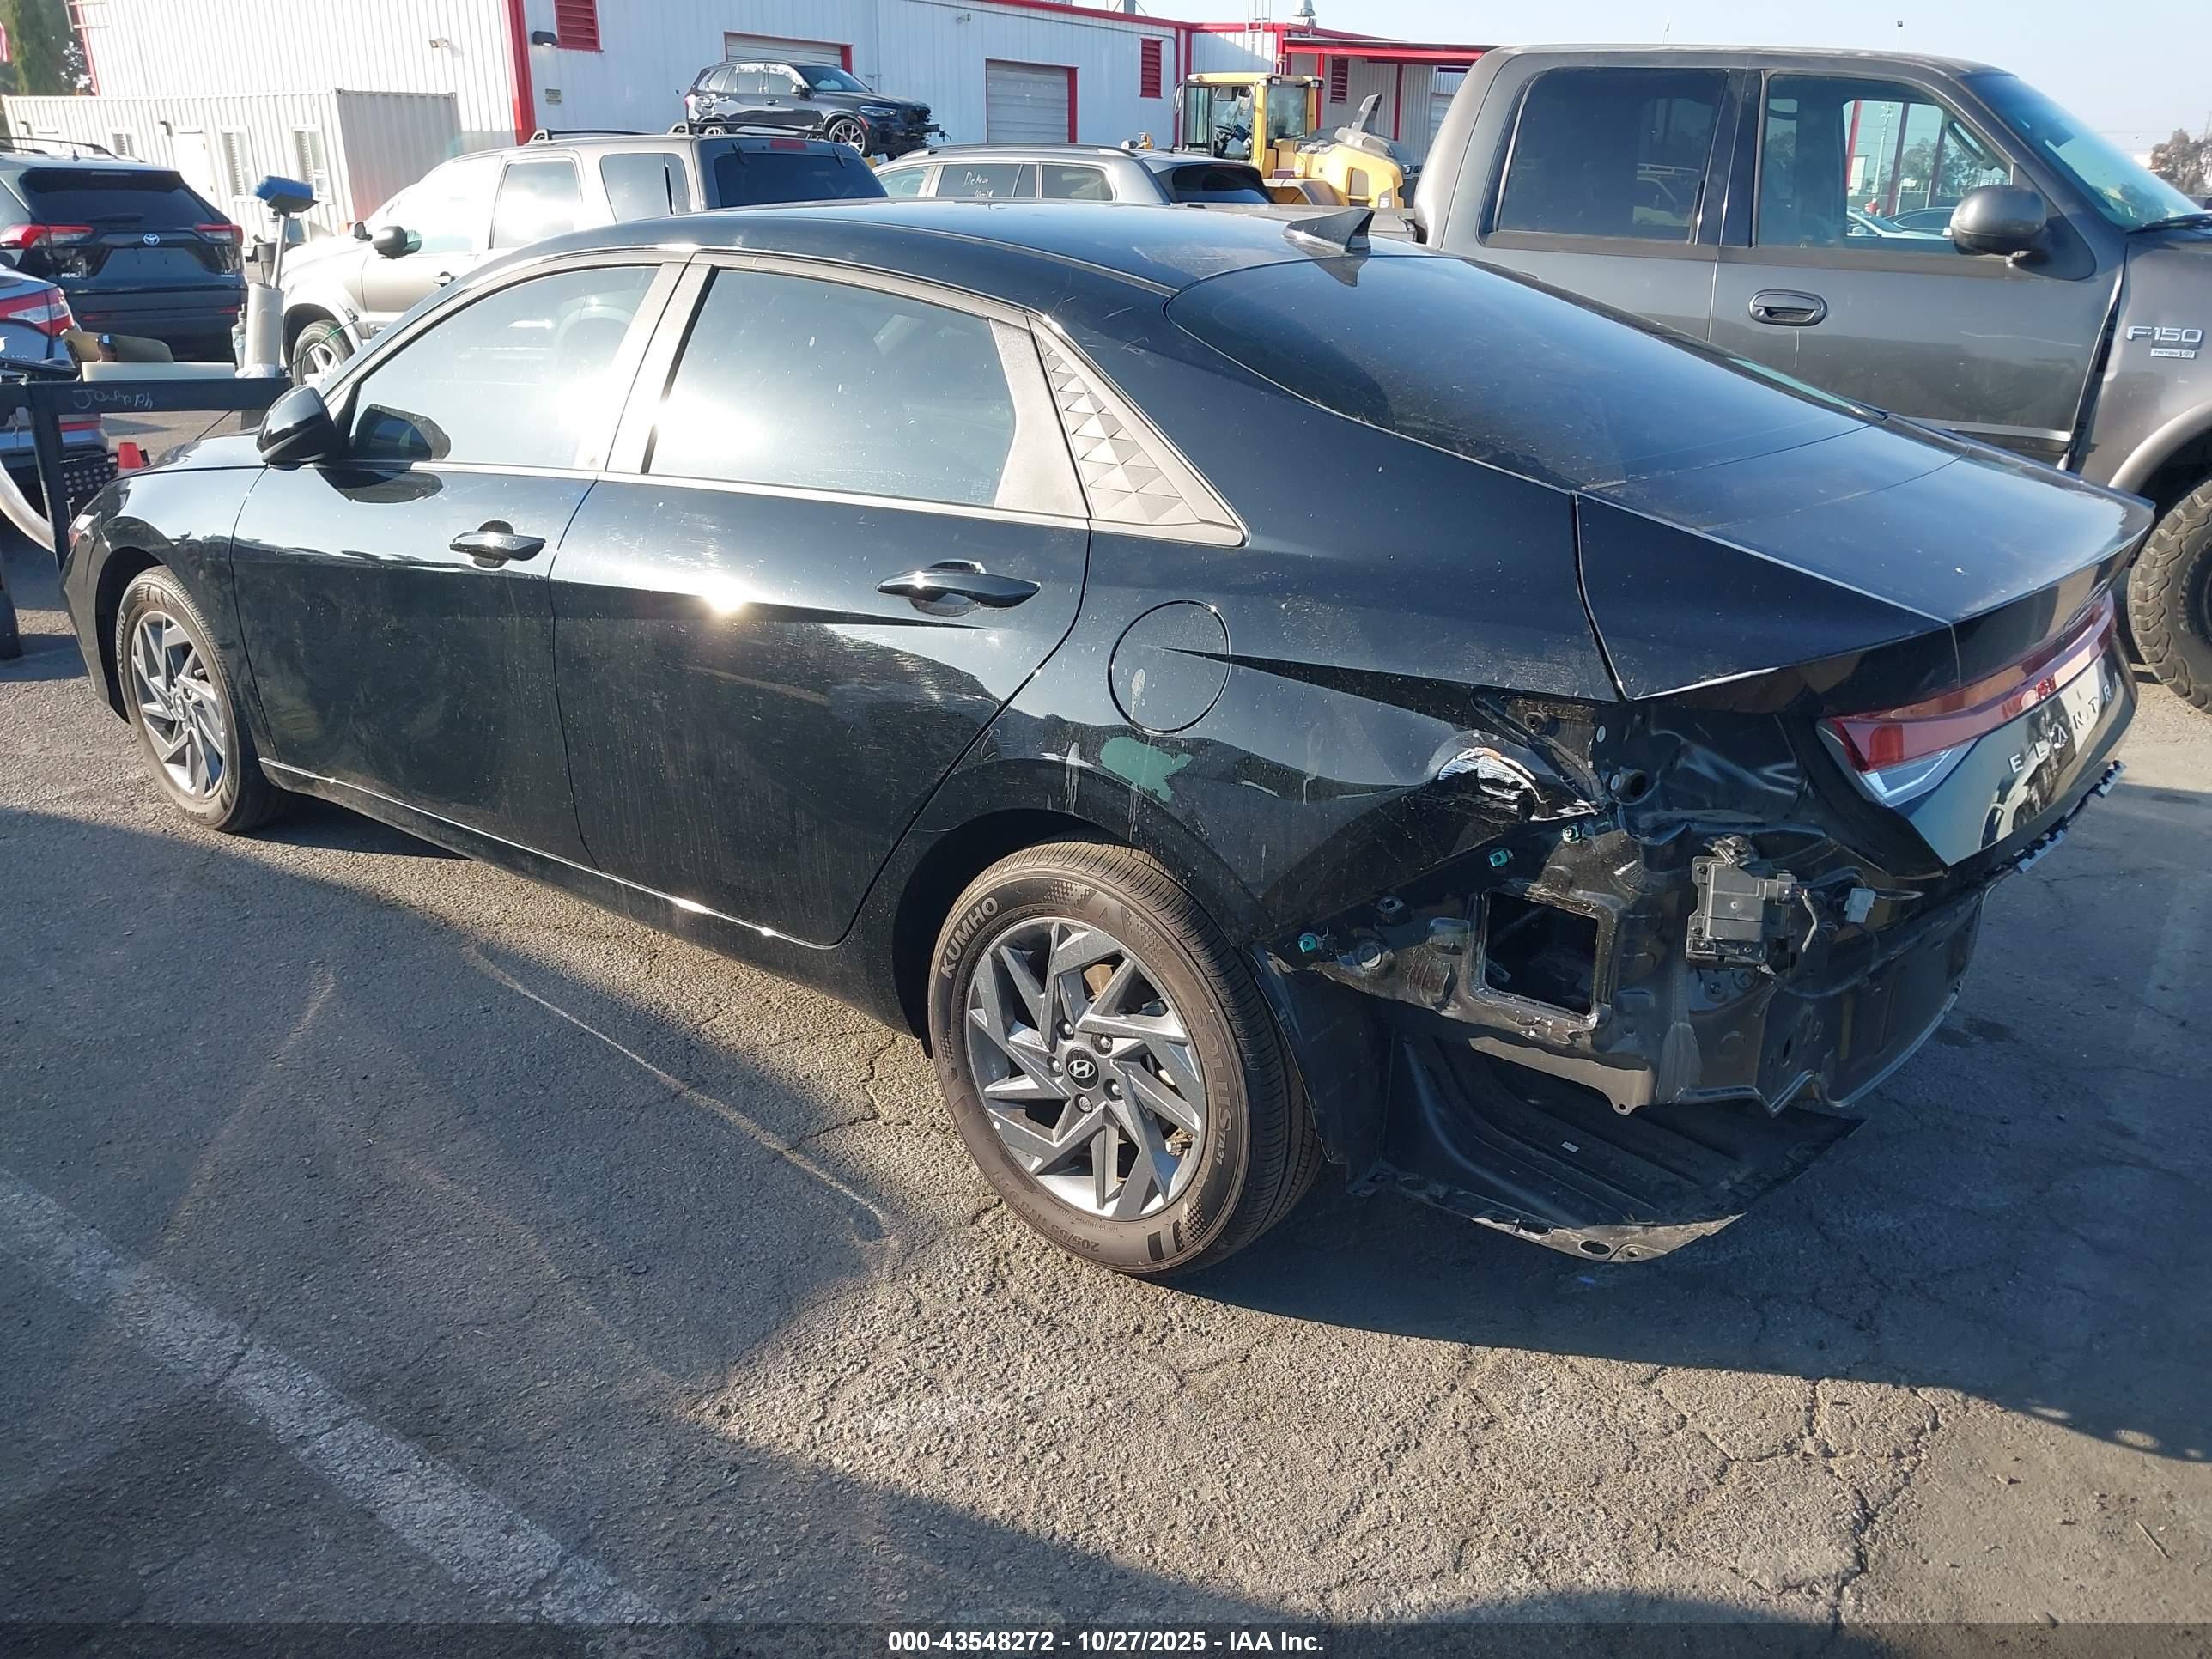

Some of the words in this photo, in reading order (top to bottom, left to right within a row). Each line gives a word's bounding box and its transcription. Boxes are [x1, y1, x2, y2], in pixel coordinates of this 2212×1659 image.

[2008, 672, 2124, 774] ELANTRA
[940, 896, 999, 980] KUMHO
[1190, 1005, 1233, 1132] SOLUS
